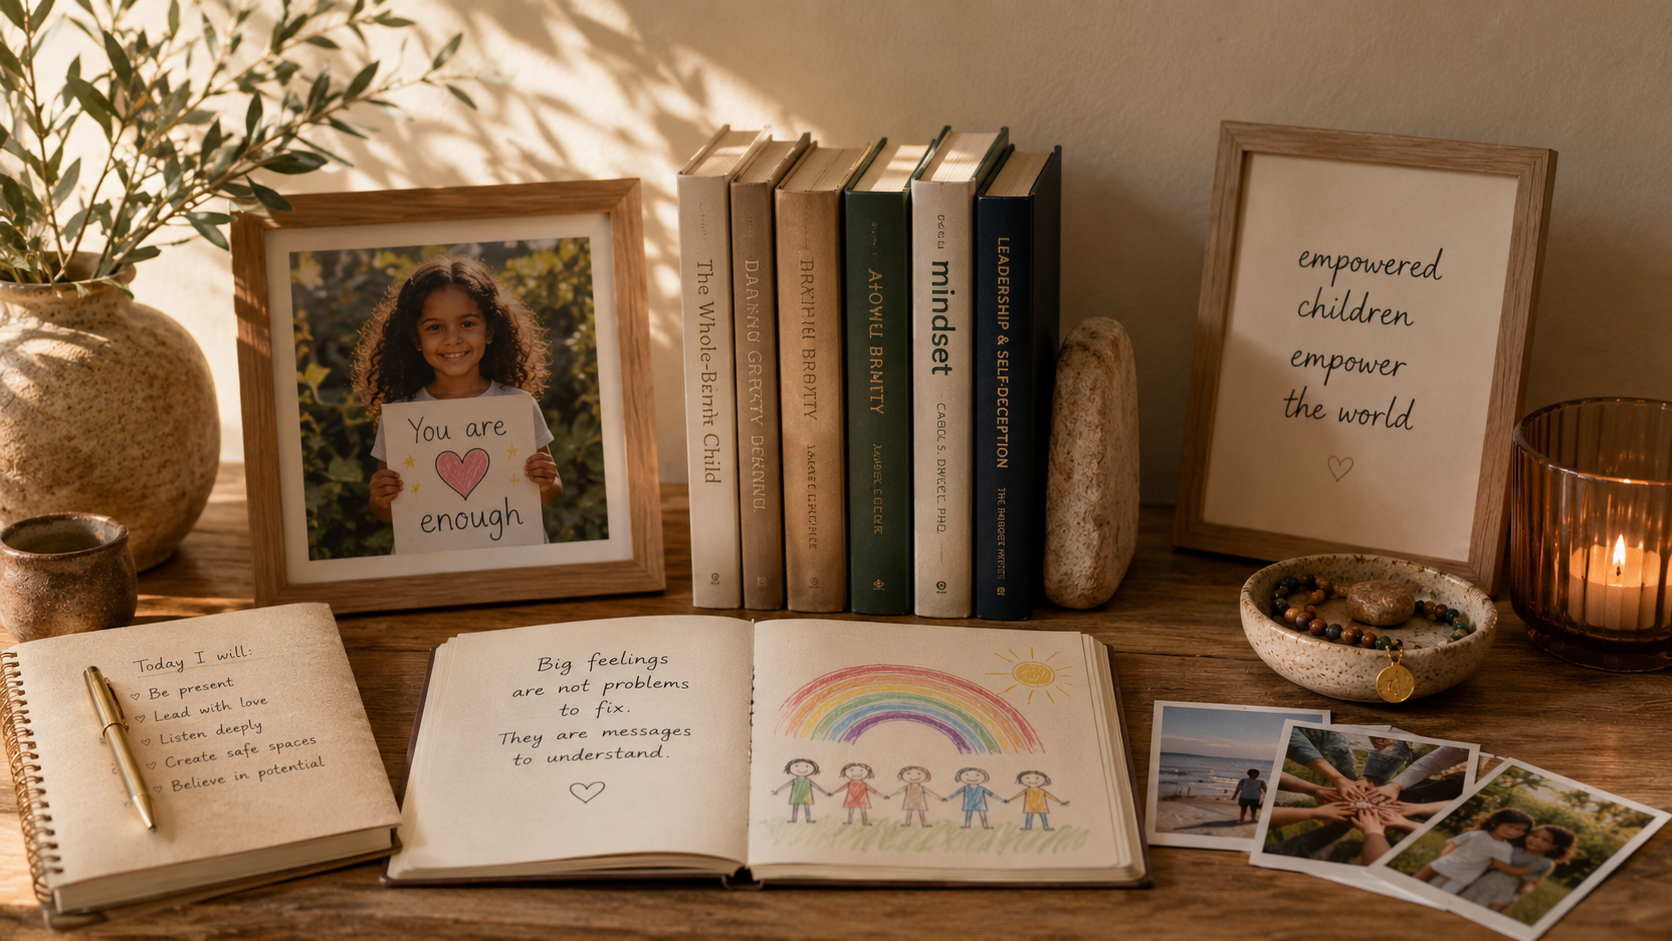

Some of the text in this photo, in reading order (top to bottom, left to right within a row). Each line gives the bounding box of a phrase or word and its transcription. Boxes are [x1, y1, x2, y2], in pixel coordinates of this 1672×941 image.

[697, 258, 714, 295] The
[1299, 248, 1443, 286] empowered
[931, 260, 957, 376] mindset
[1298, 287, 1414, 326] children
[996, 237, 1010, 469] LEADERSHIP & SELF-DECEPTION
[1291, 350, 1407, 386] empower
[1283, 386, 1415, 430] the world
[408, 417, 507, 443] You are
[703, 432, 722, 484] Child
[421, 496, 523, 541] enough
[133, 645, 252, 673] Today I will:
[538, 651, 668, 675] Big feelings
[149, 677, 234, 700] Be present
[512, 675, 689, 697] are not problems
[154, 697, 268, 721] Lead with love
[559, 700, 631, 718] to fix.
[160, 719, 262, 744] Listen deeply
[499, 728, 691, 748] They are messages
[165, 737, 316, 768] Create safe spaces
[513, 745, 669, 766] to understand.
[172, 777, 225, 792] Believe
[258, 756, 325, 782] potential
